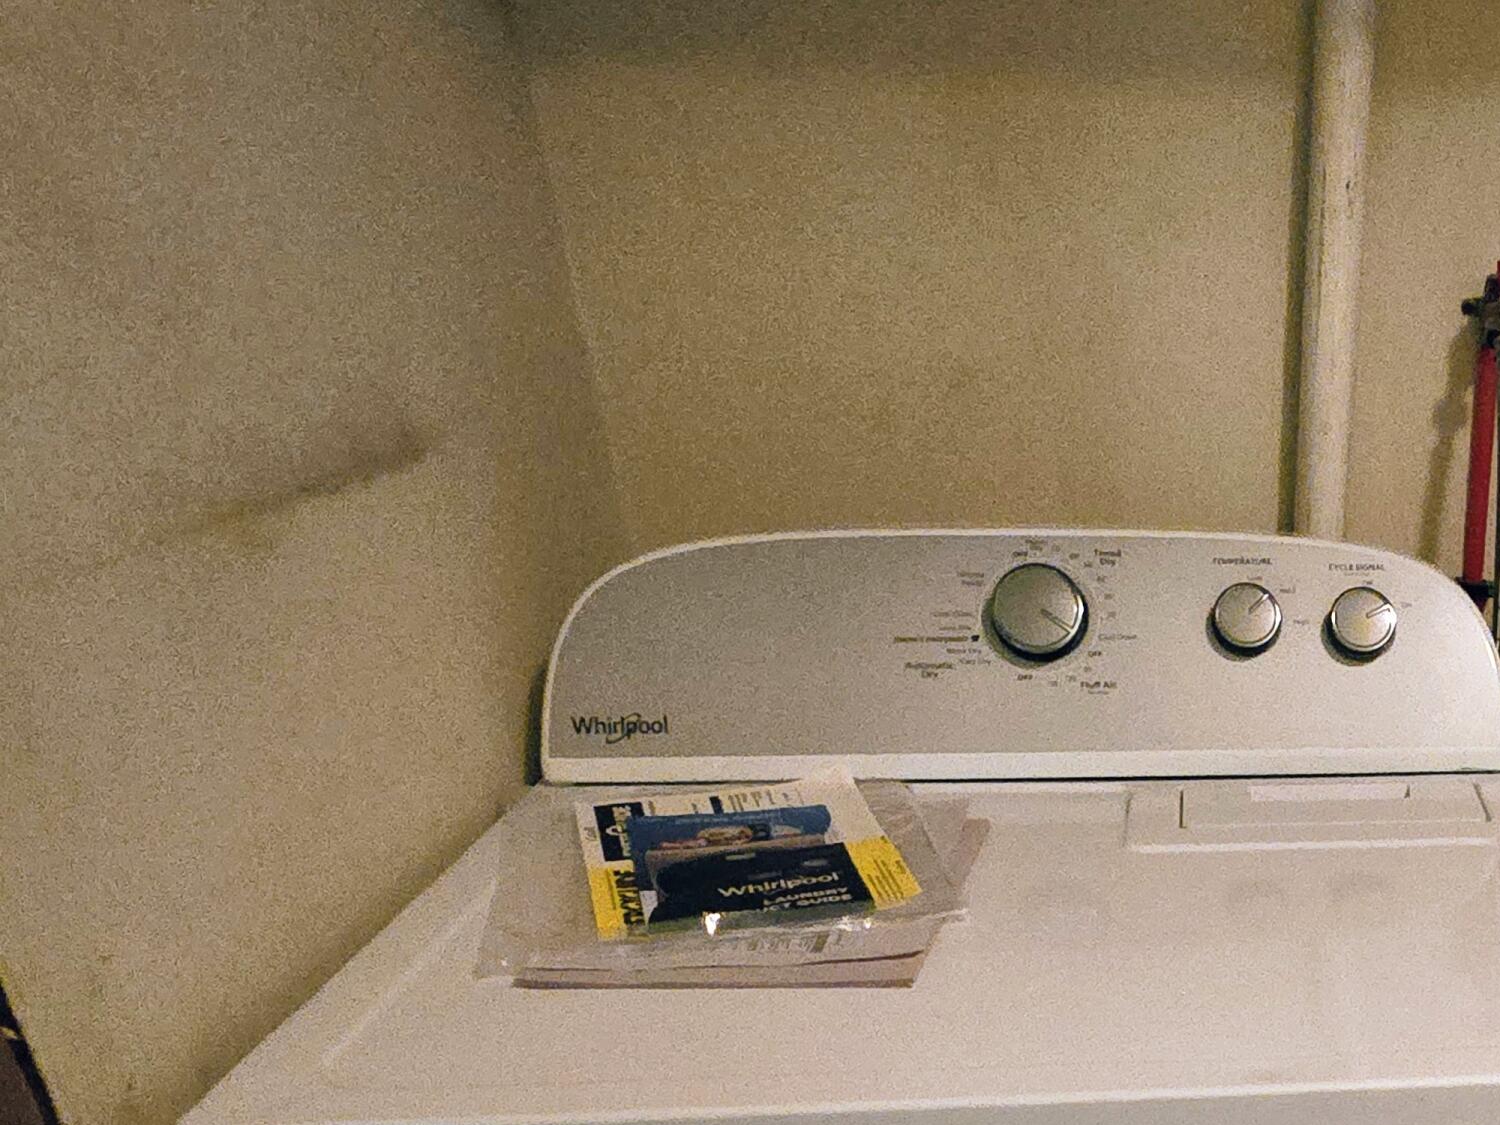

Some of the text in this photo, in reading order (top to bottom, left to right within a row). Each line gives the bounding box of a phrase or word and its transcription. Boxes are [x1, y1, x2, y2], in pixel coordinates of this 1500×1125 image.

[1212, 556, 1273, 565] TEMPERATURE
[1328, 562, 1386, 572] CYCLE SIGNAL
[570, 712, 669, 744] Whirlpool
[717, 871, 840, 897] Whirlpool
[762, 886, 849, 906] LAUNDRY
[796, 893, 853, 907] GUIDE
